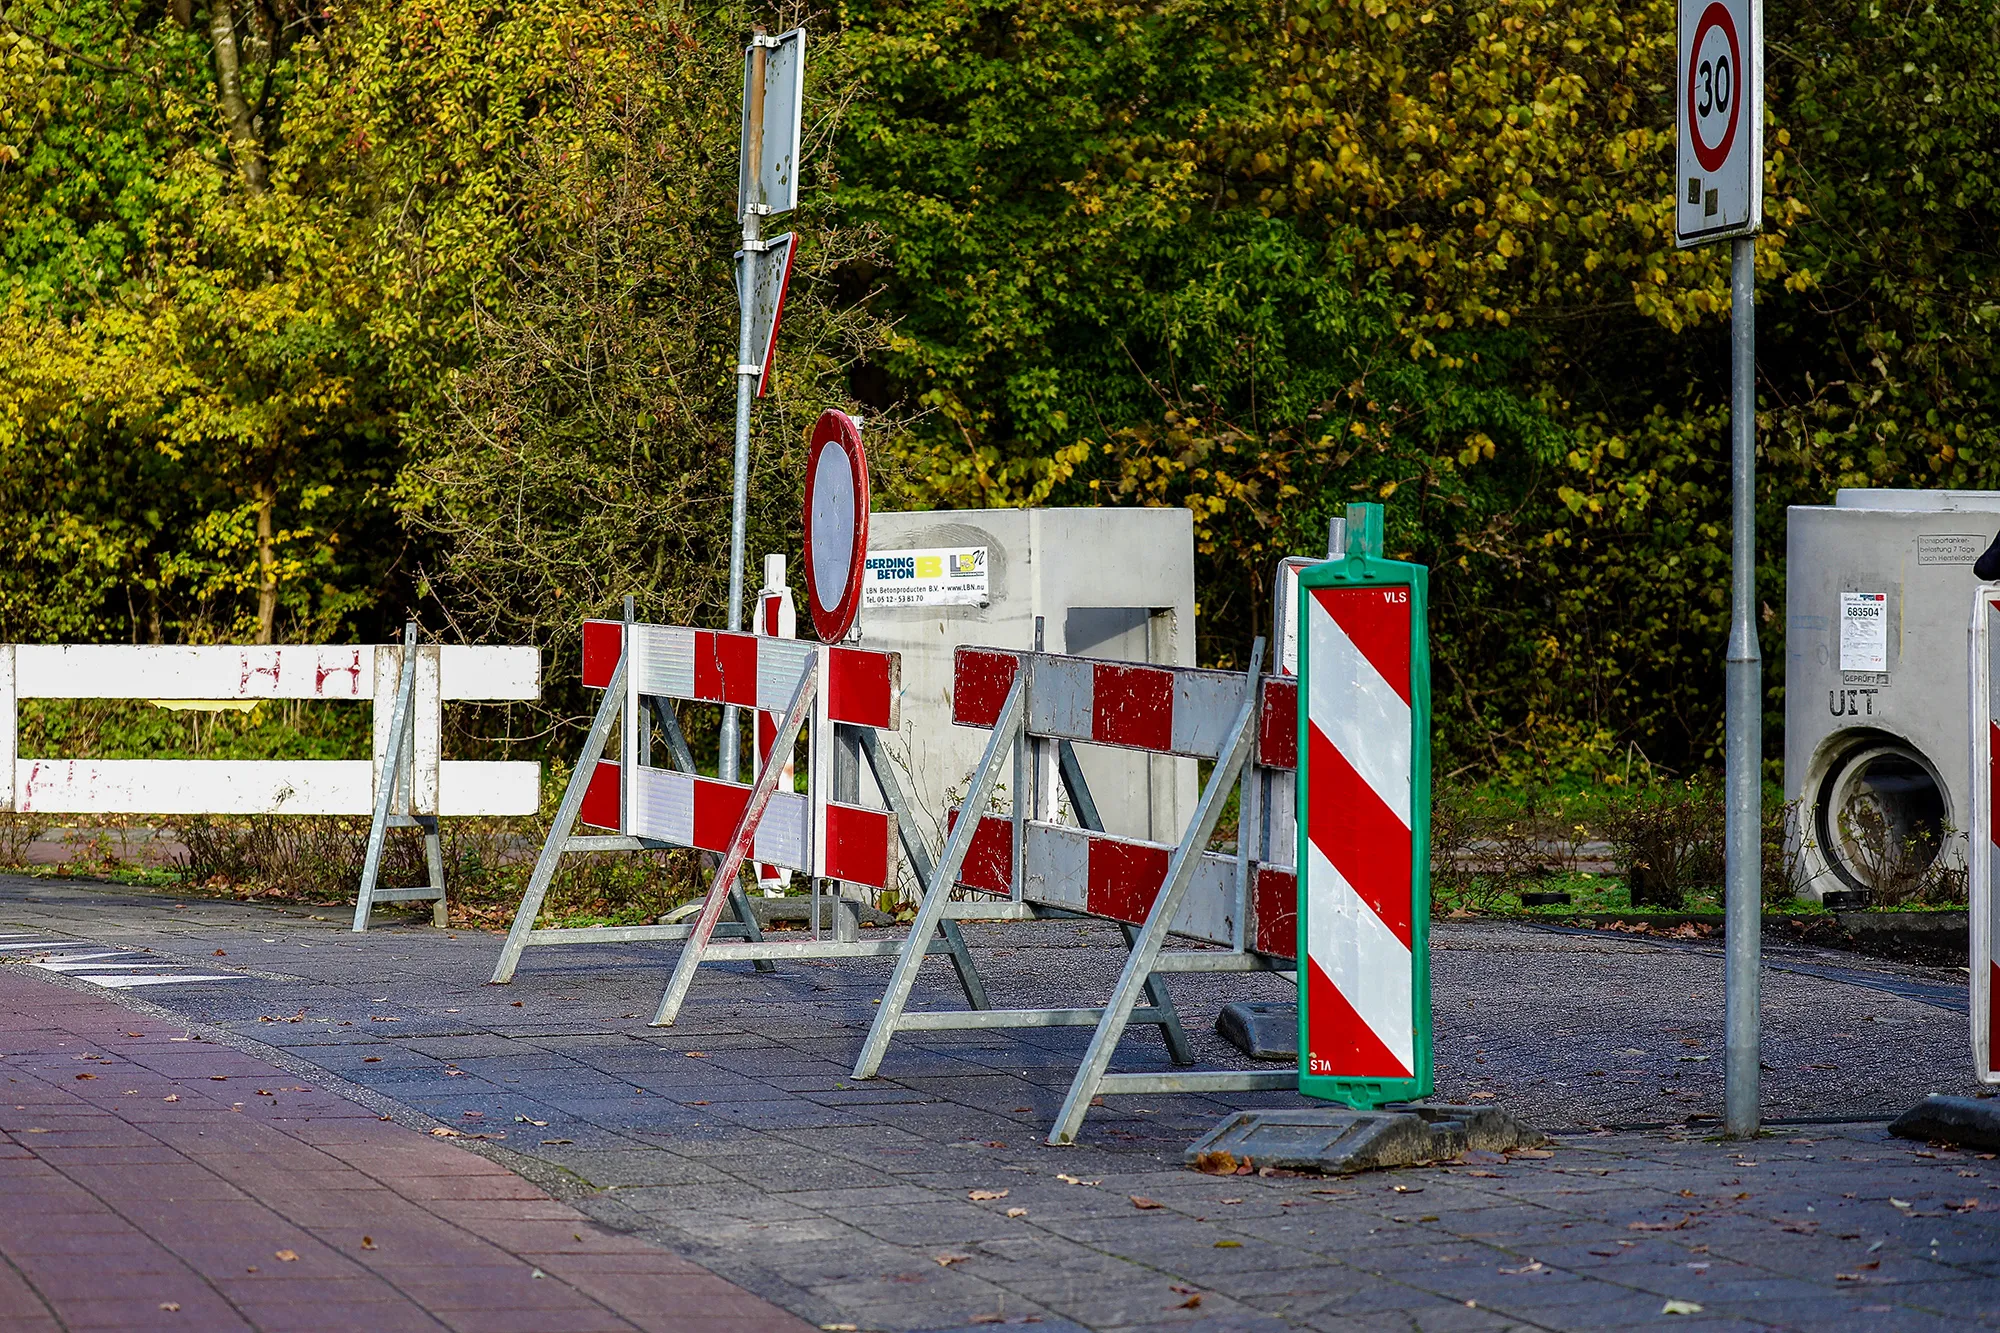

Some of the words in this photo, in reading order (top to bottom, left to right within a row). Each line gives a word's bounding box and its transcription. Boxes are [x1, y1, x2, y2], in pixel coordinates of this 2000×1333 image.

[1698, 55, 1730, 118] 30
[866, 557, 914, 569] BERDING
[877, 568, 914, 580] BETON
[880, 586, 926, 594] Betonproducten
[947, 583, 984, 591] www.LBN.nu
[1383, 591, 1407, 603] VLS
[1847, 607, 1879, 617] 683504
[1844, 674, 1876, 683] GEPRÜFT
[1829, 688, 1879, 716] UIT
[1310, 1059, 1332, 1071] VLS
